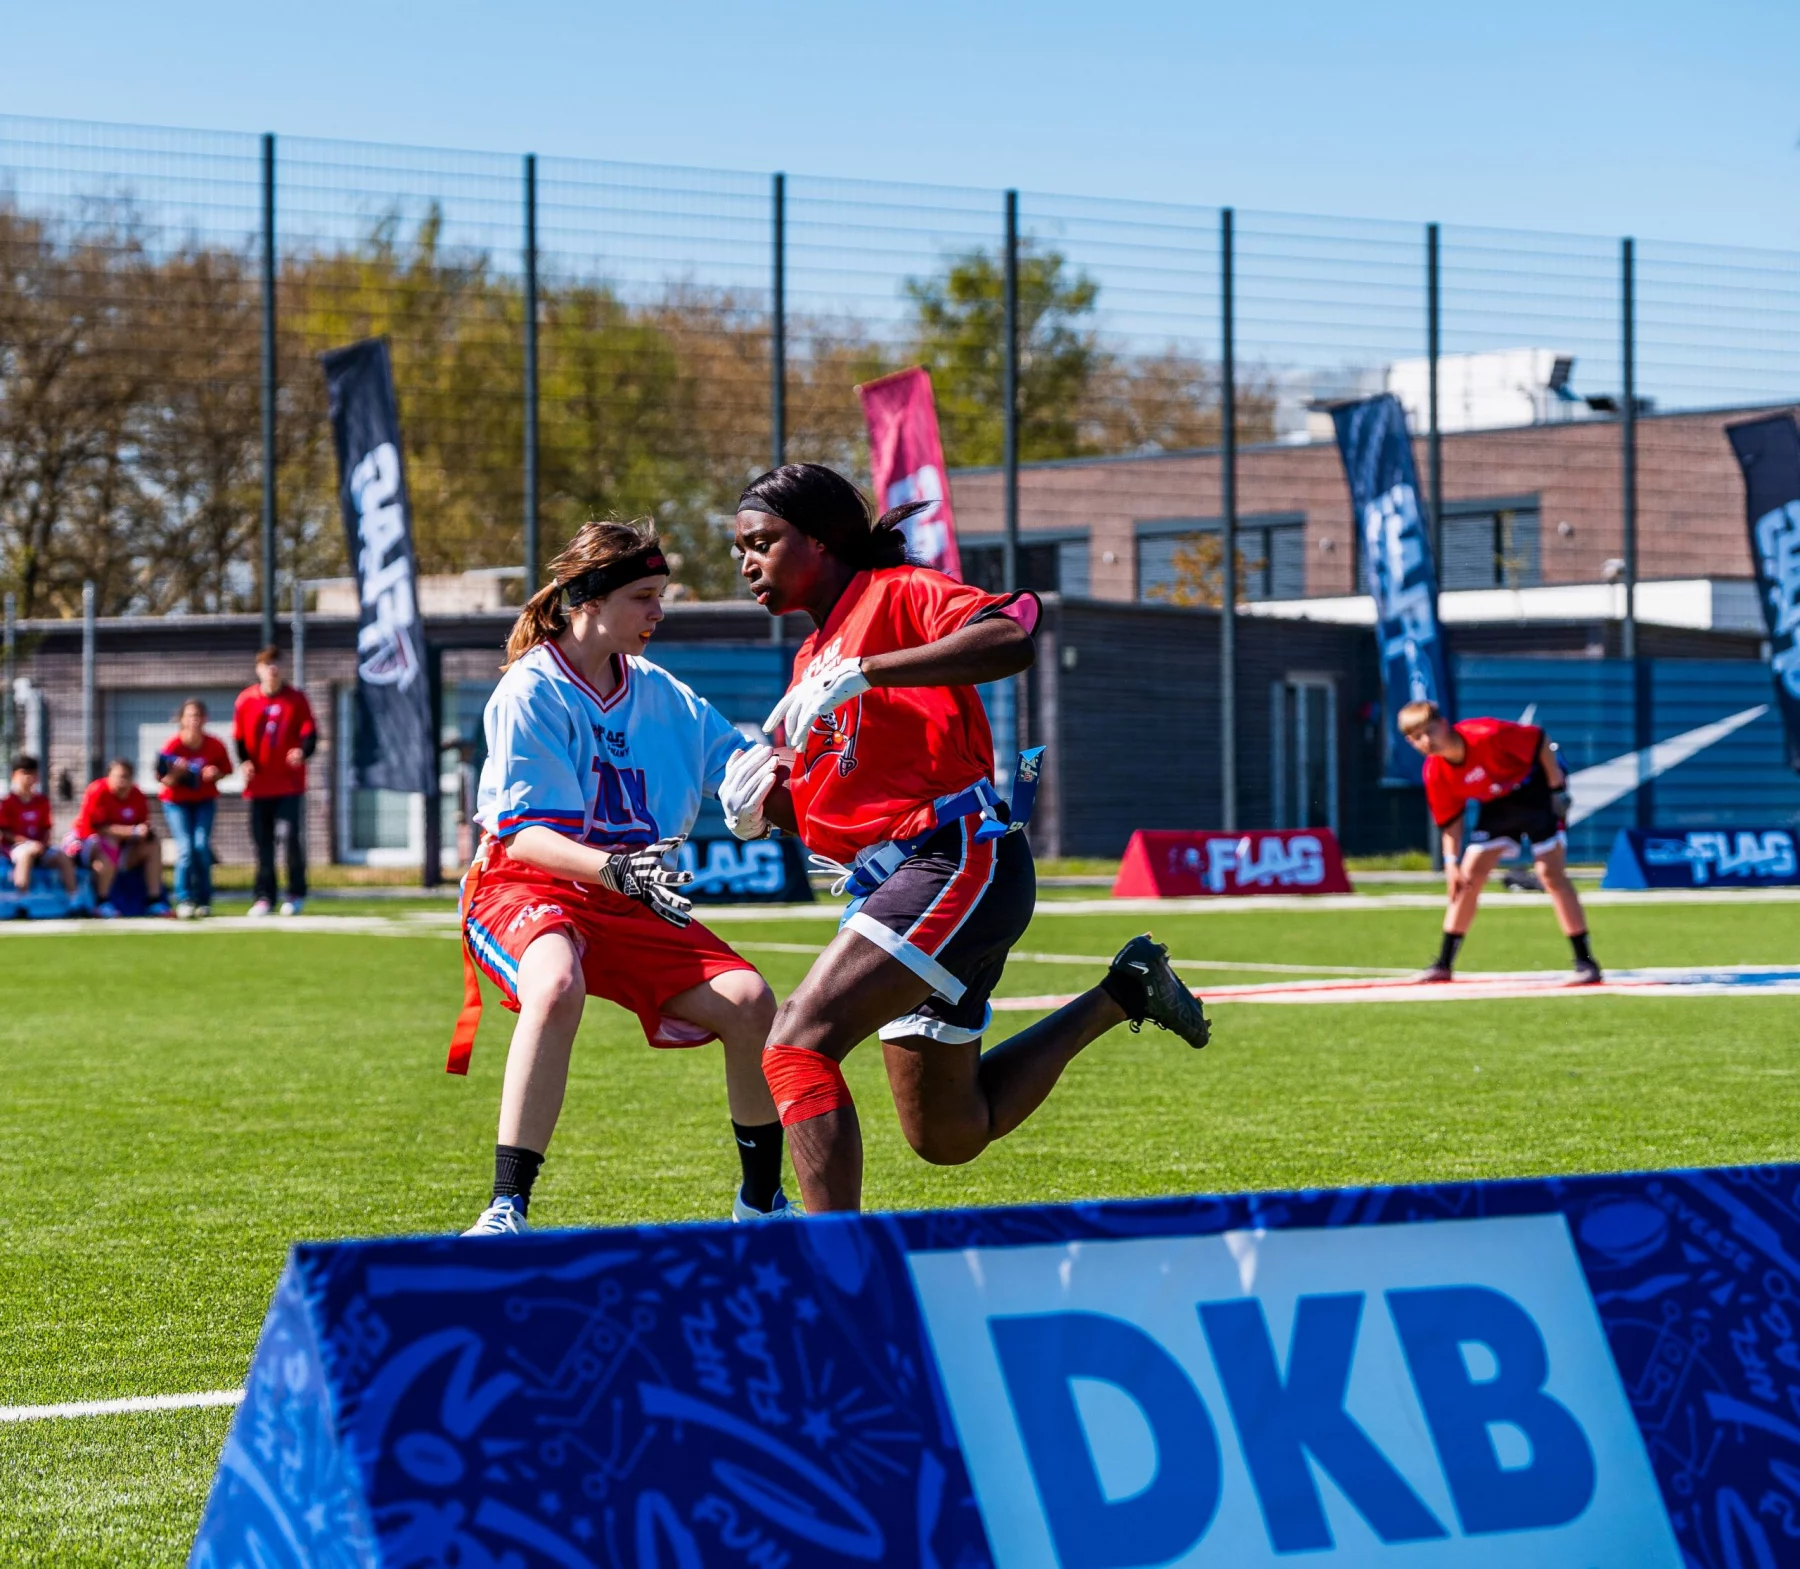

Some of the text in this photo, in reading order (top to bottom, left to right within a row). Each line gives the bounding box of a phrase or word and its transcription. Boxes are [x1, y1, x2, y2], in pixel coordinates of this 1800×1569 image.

[678, 840, 787, 893] LAG
[1206, 835, 1325, 892] FLAG
[1686, 831, 1797, 884] FLAG
[680, 1298, 736, 1397] NFL
[722, 1284, 792, 1426] FLAG
[1728, 1314, 1781, 1403] NFL
[986, 1284, 1597, 1569] DKB
